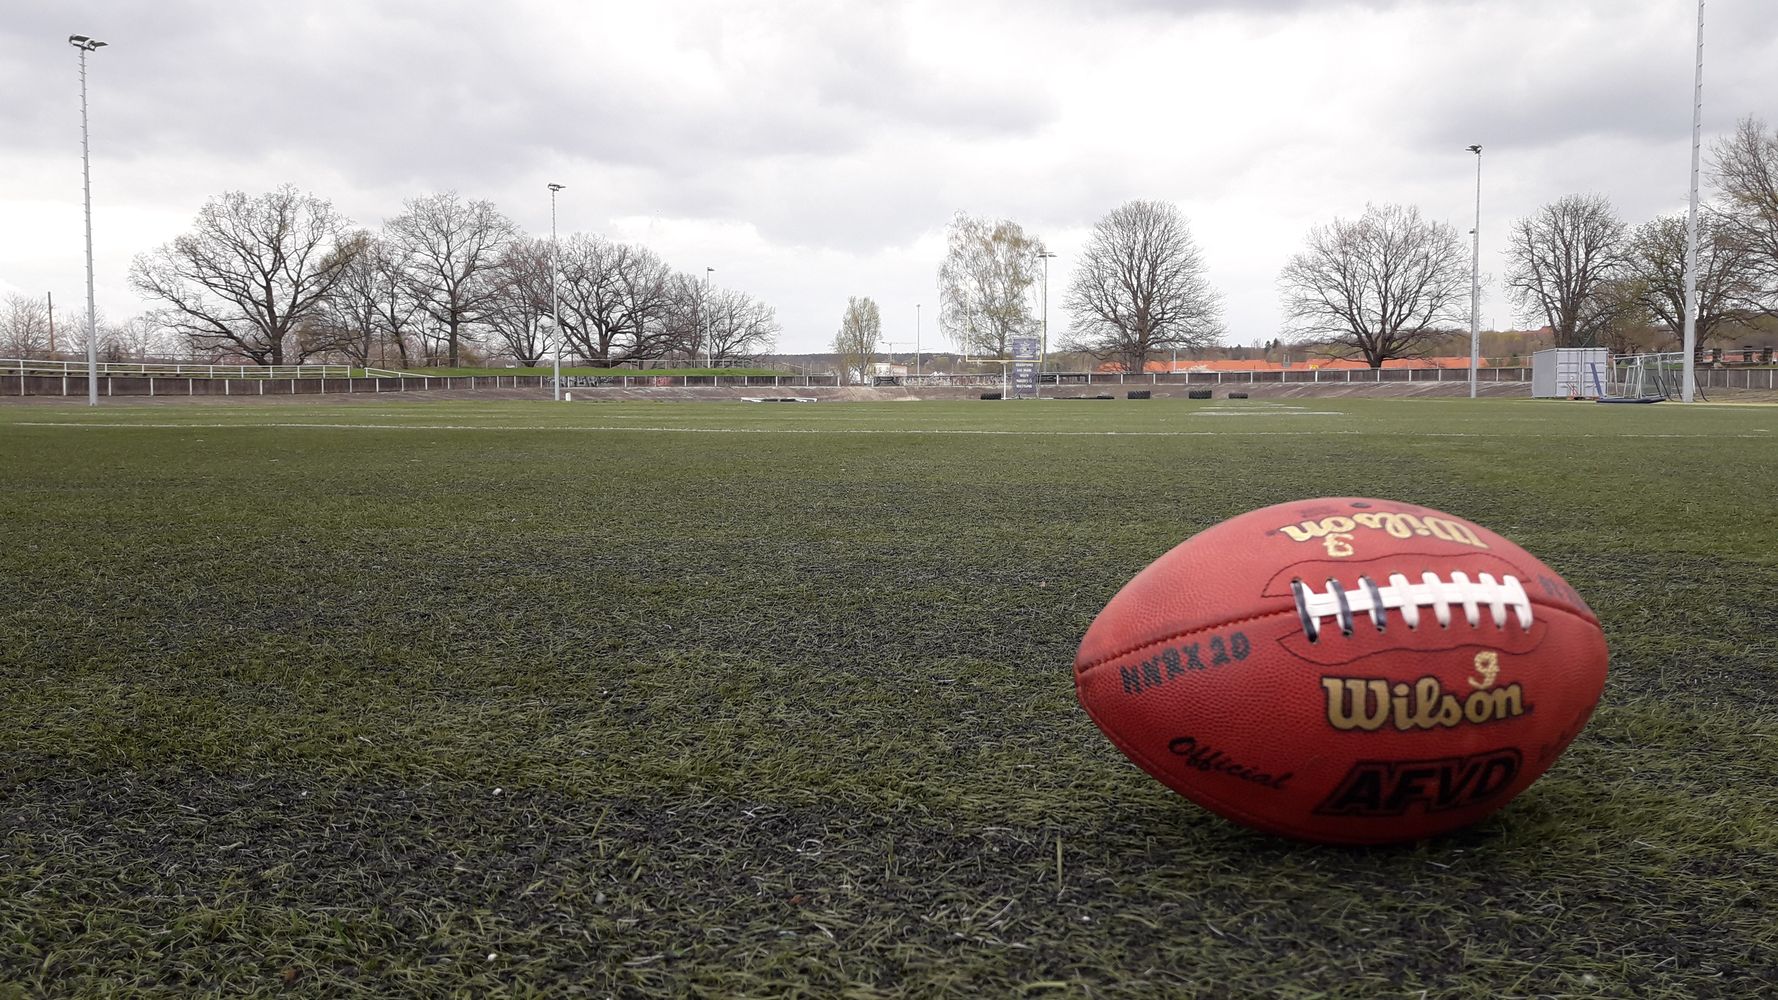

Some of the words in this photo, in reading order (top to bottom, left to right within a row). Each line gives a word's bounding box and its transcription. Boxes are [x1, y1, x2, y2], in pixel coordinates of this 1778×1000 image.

[1279, 511, 1490, 549] Wilson
[1321, 674, 1525, 731] Wilson
[1167, 735, 1293, 790] Official
[1320, 750, 1521, 815] AFVD
